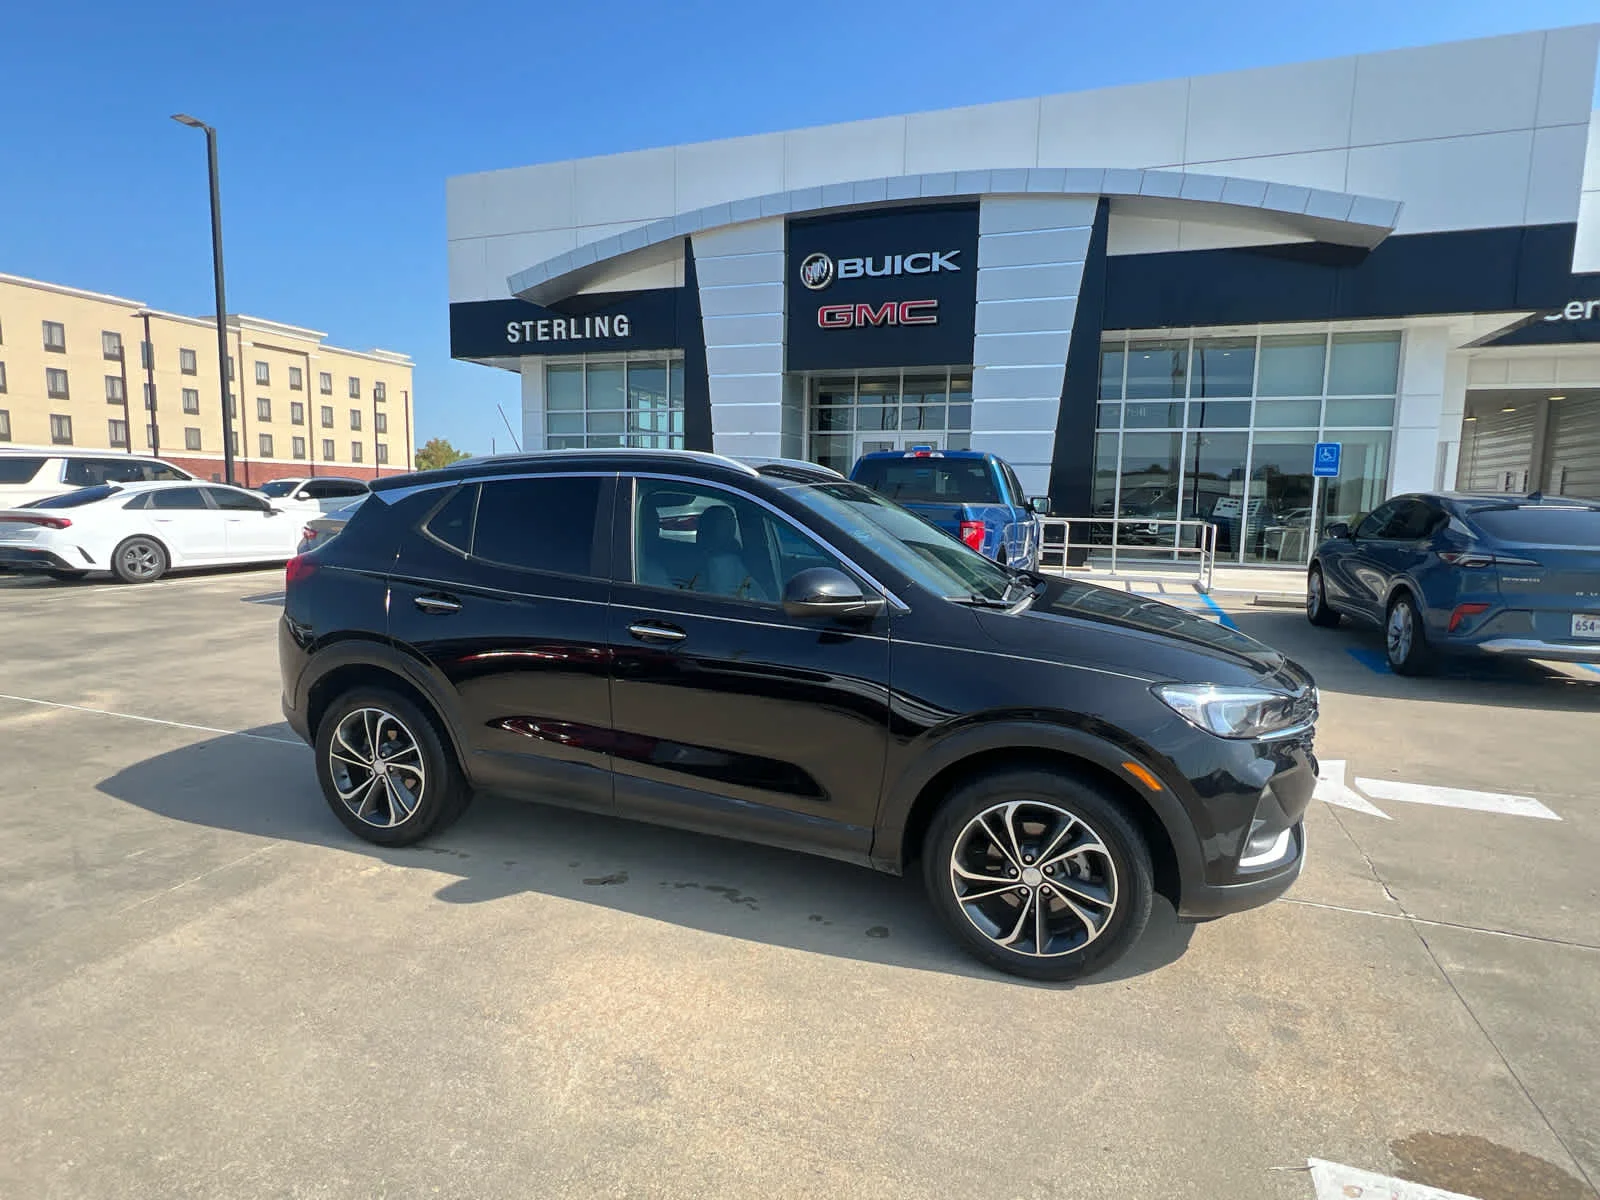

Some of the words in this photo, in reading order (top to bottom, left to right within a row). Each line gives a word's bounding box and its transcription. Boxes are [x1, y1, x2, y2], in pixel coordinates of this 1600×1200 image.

[837, 250, 961, 279] BUICK
[817, 299, 938, 328] GMC
[1544, 300, 1600, 321] er
[506, 314, 629, 343] STERLING
